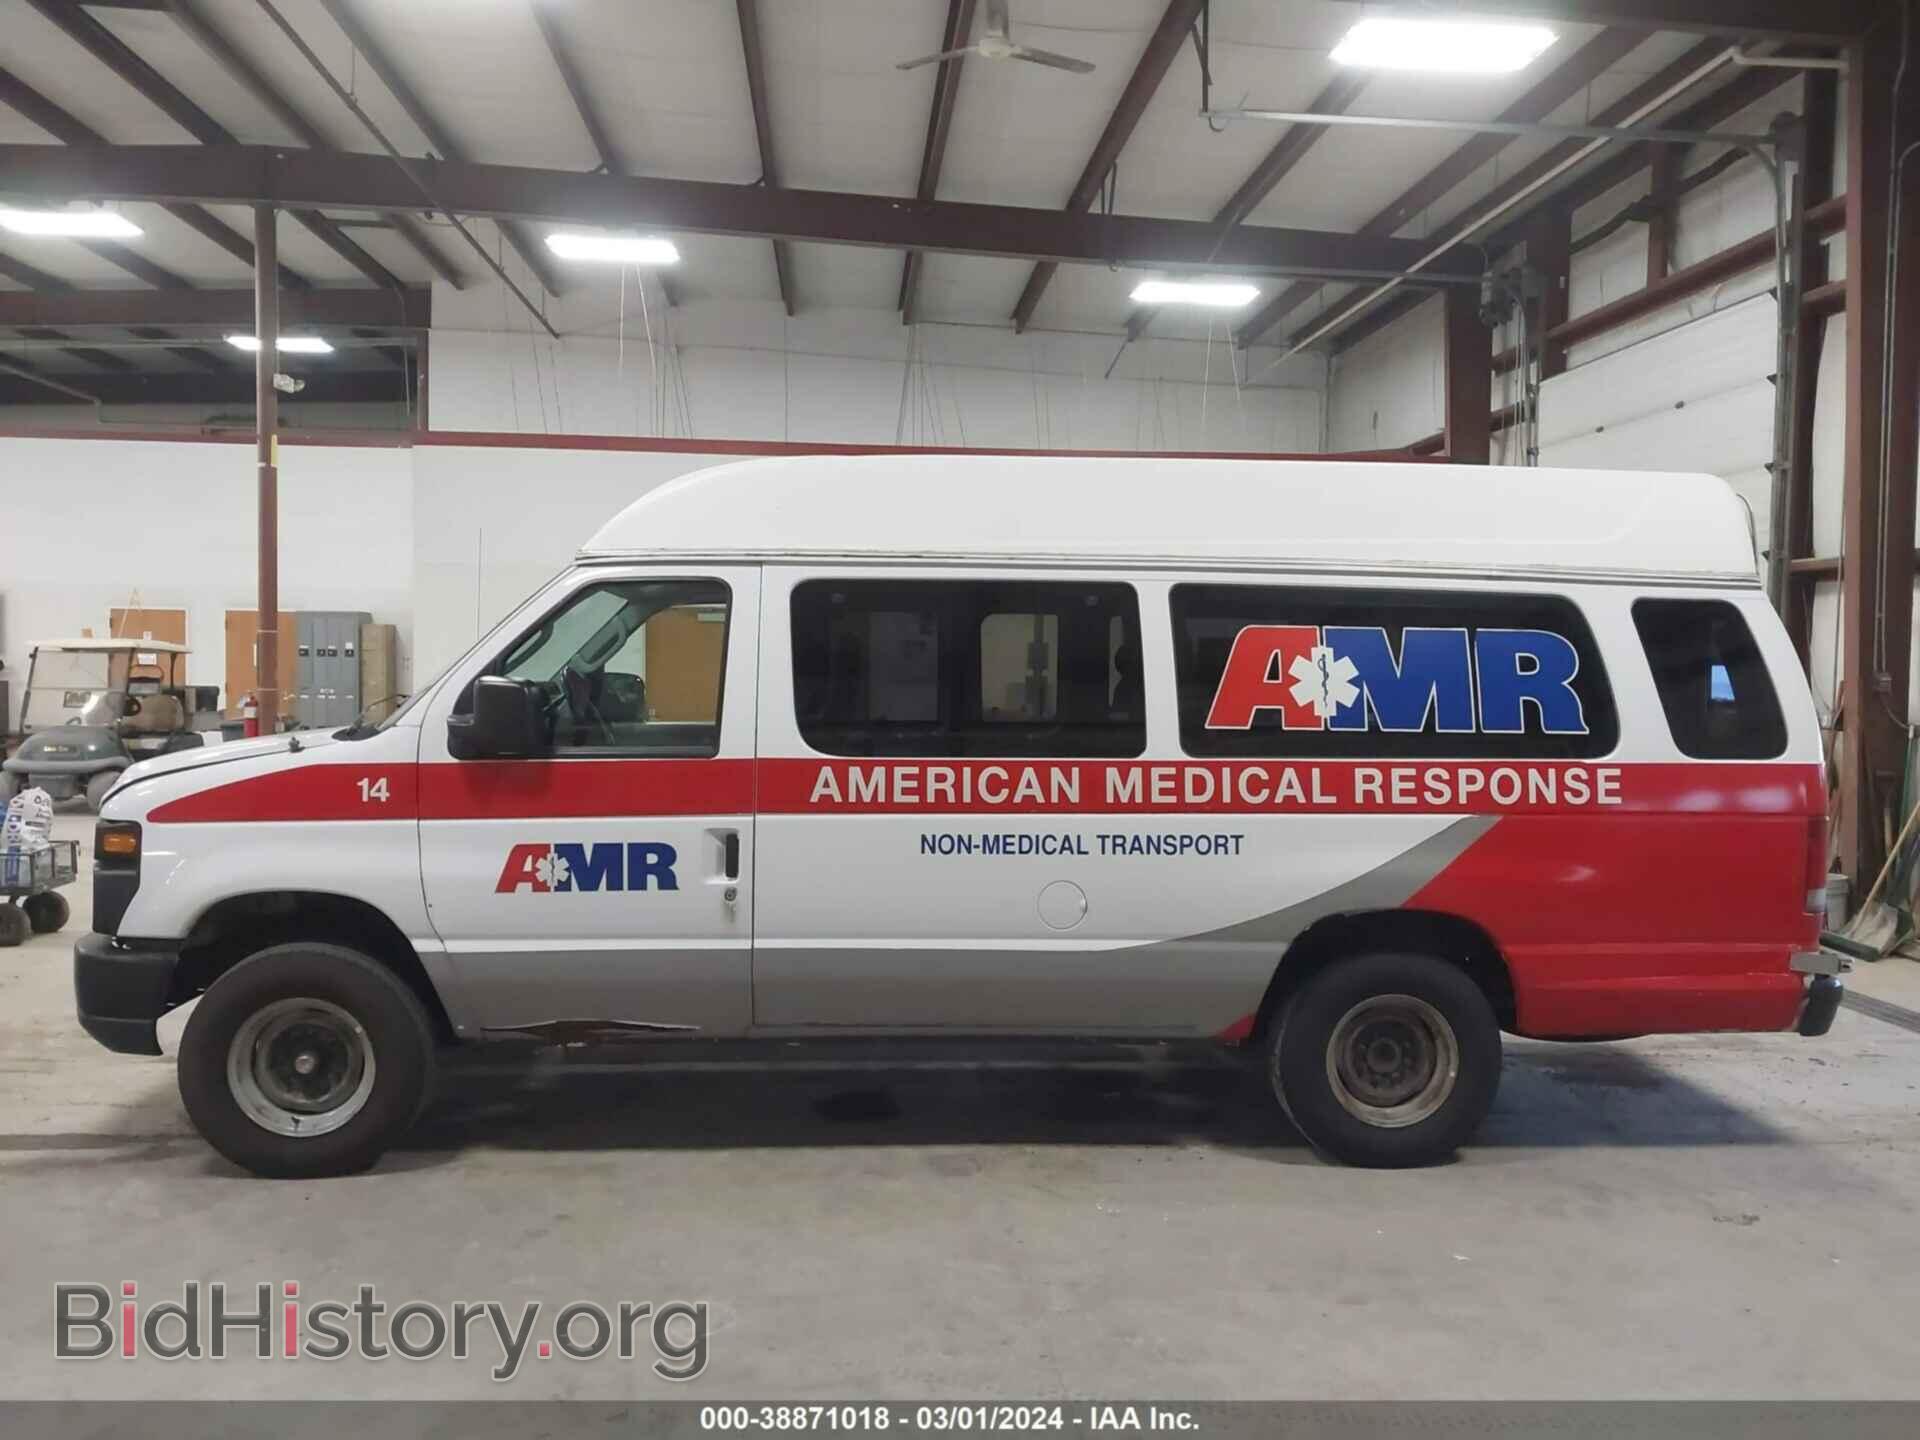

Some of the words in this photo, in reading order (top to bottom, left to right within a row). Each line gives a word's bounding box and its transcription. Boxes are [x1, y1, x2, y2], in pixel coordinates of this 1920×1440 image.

[1204, 624, 1589, 735] AMR
[357, 777, 390, 803] 14
[810, 766, 1081, 804] AMERICAN
[1106, 766, 1337, 805] MEDICAL
[1354, 767, 1623, 806] RESPONSE
[920, 833, 1090, 857] NON-MEDICAL
[1096, 833, 1245, 857] TRANSPORT
[495, 842, 678, 893] AMR
